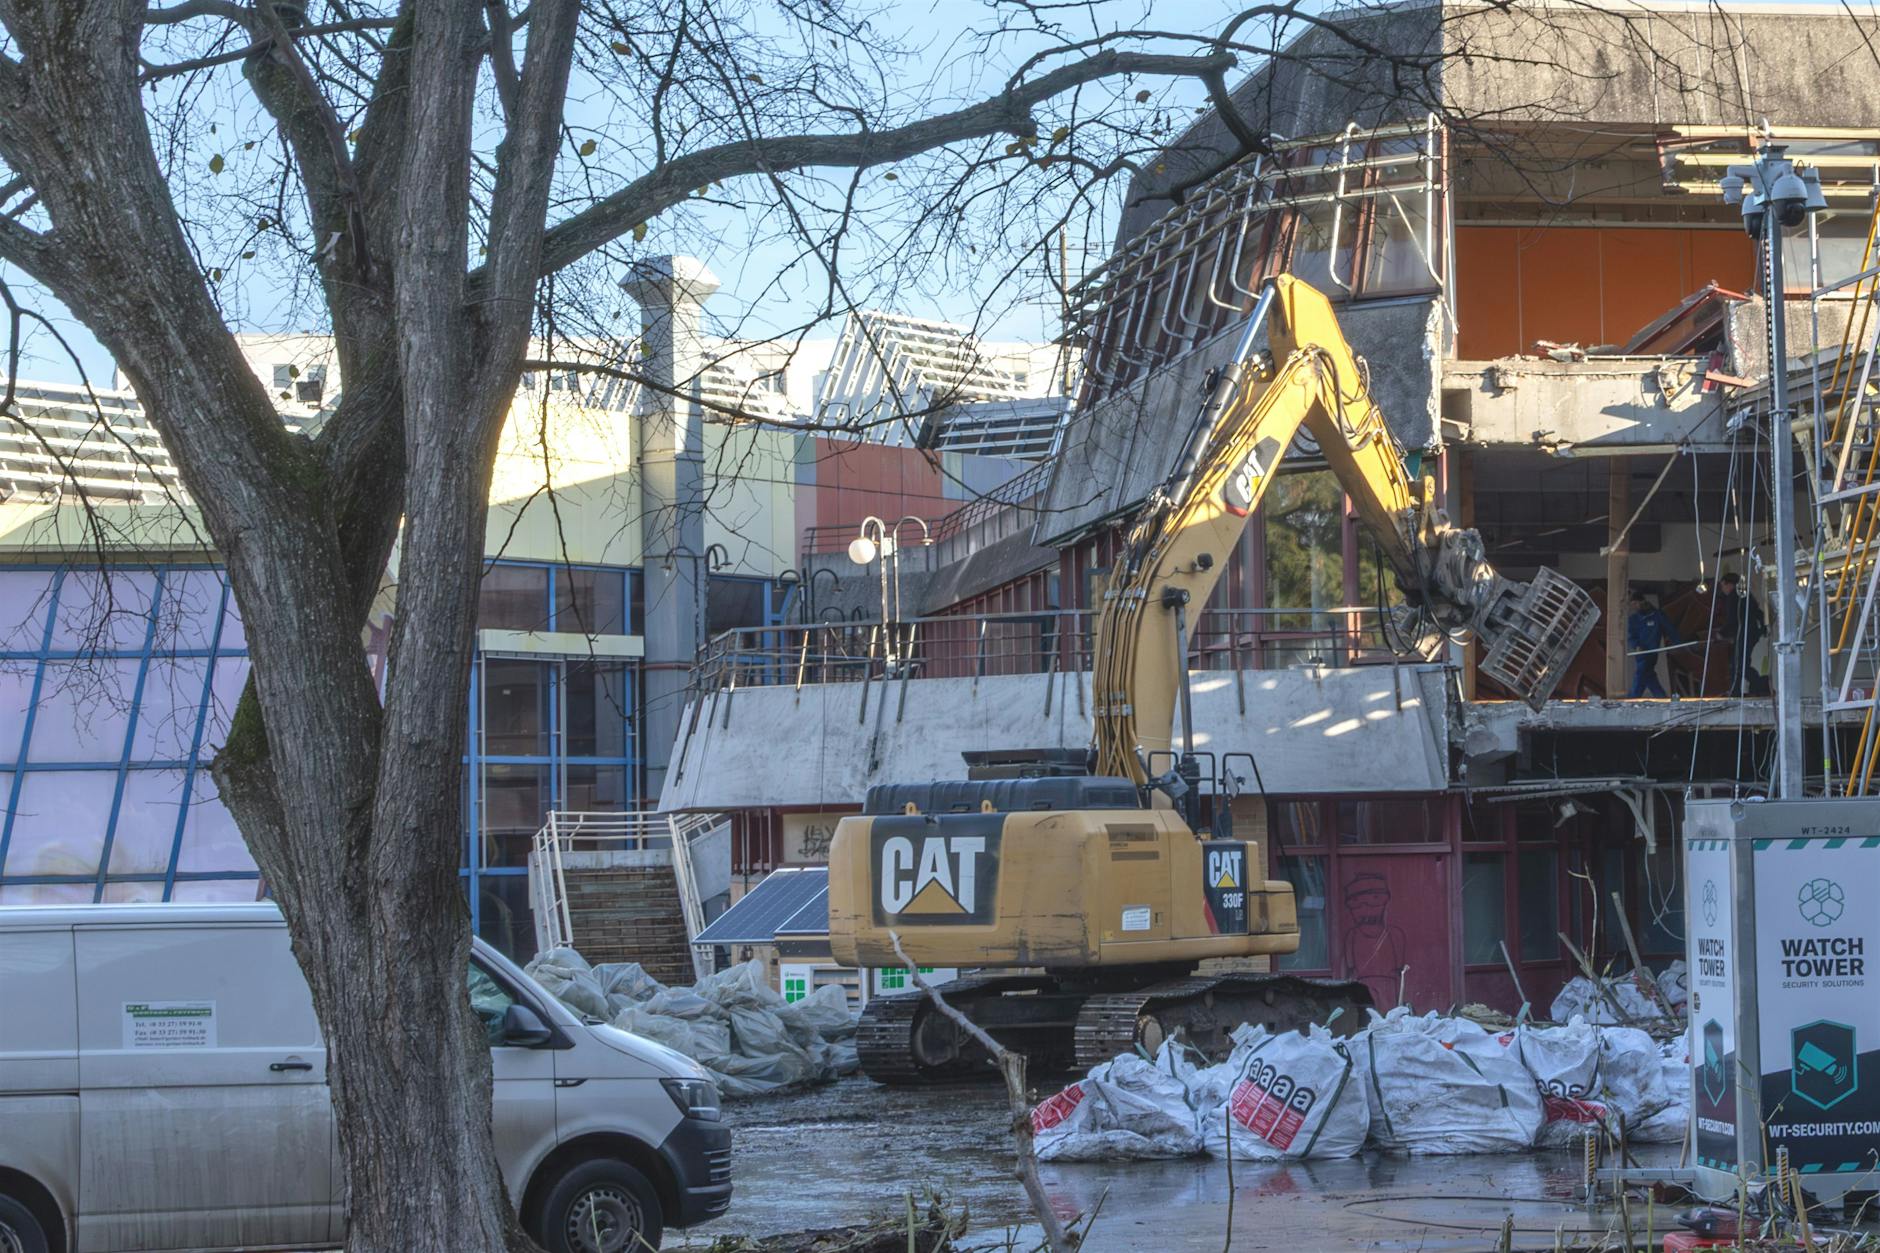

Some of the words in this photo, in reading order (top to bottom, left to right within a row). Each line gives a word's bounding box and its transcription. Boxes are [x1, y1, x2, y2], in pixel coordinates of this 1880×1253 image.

[1236, 449, 1265, 503] CAT
[1801, 826, 1850, 835] WT-2424
[881, 836, 985, 914] CAT
[1209, 850, 1241, 888] CAT
[1222, 892, 1244, 909] 330F
[1698, 938, 1725, 957] WATCH
[1780, 937, 1864, 957] WATCH
[1699, 958, 1725, 977] TOWER
[1781, 958, 1864, 978] TOWER
[1782, 981, 1818, 989] SECURITY
[1822, 980, 1864, 988] SOLUTIONS
[1769, 1121, 1880, 1138] WT-SECURITY.COM
